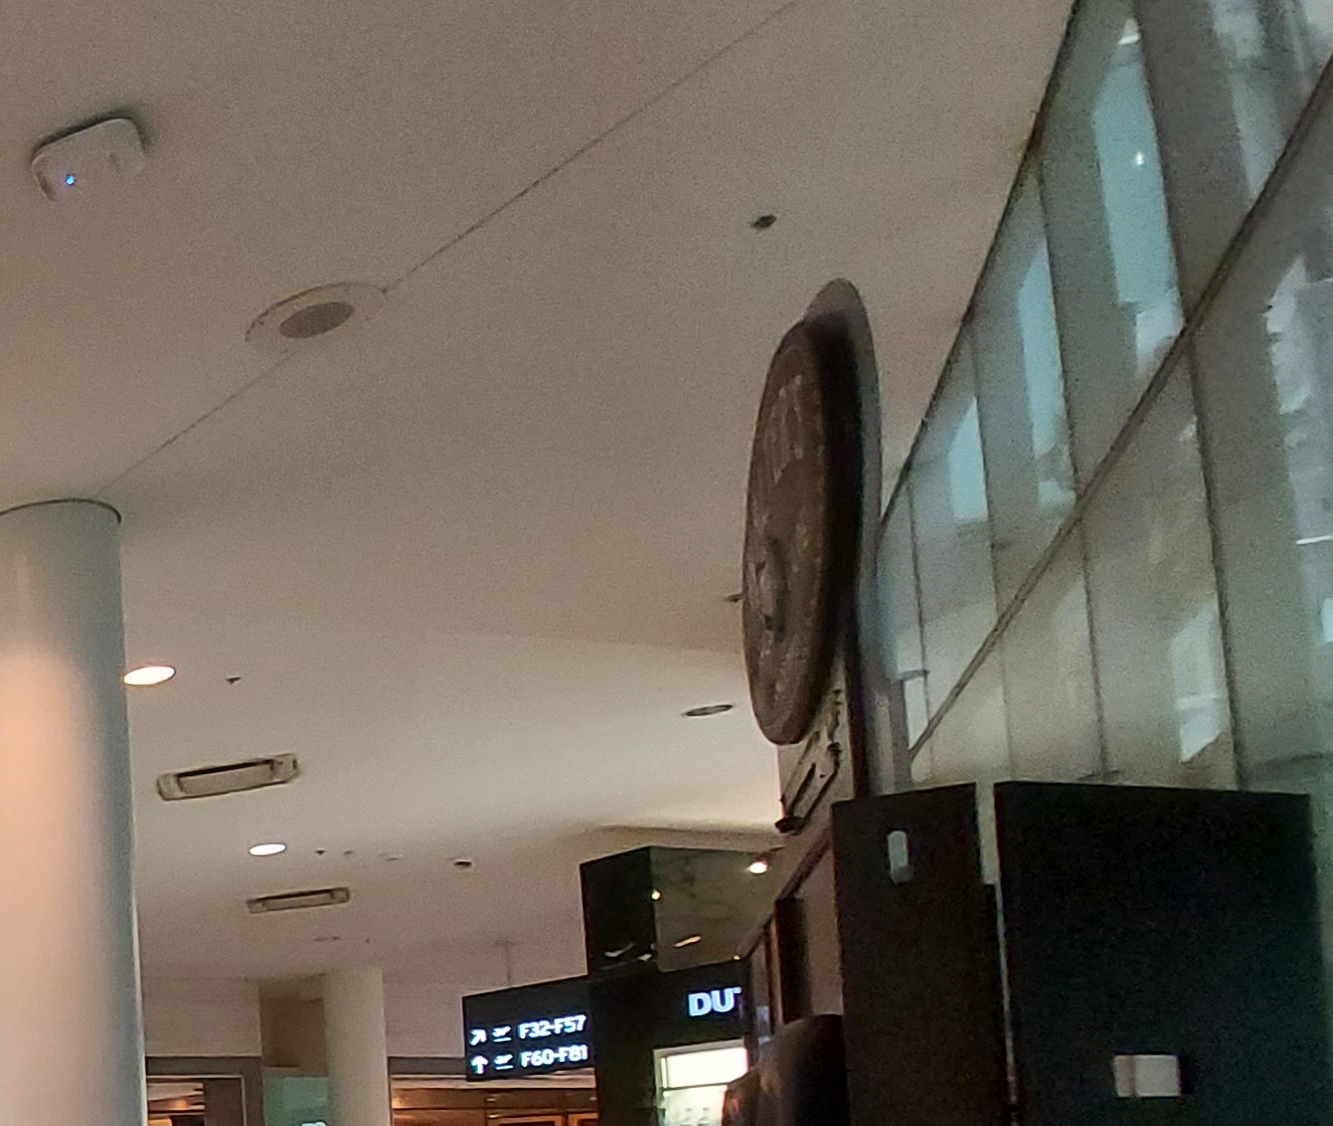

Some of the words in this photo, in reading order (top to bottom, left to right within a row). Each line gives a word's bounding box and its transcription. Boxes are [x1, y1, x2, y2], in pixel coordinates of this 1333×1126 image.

[688, 986, 742, 1017] DU
[517, 1014, 587, 1039] F32-F57
[519, 1044, 589, 1068] F60-F81
